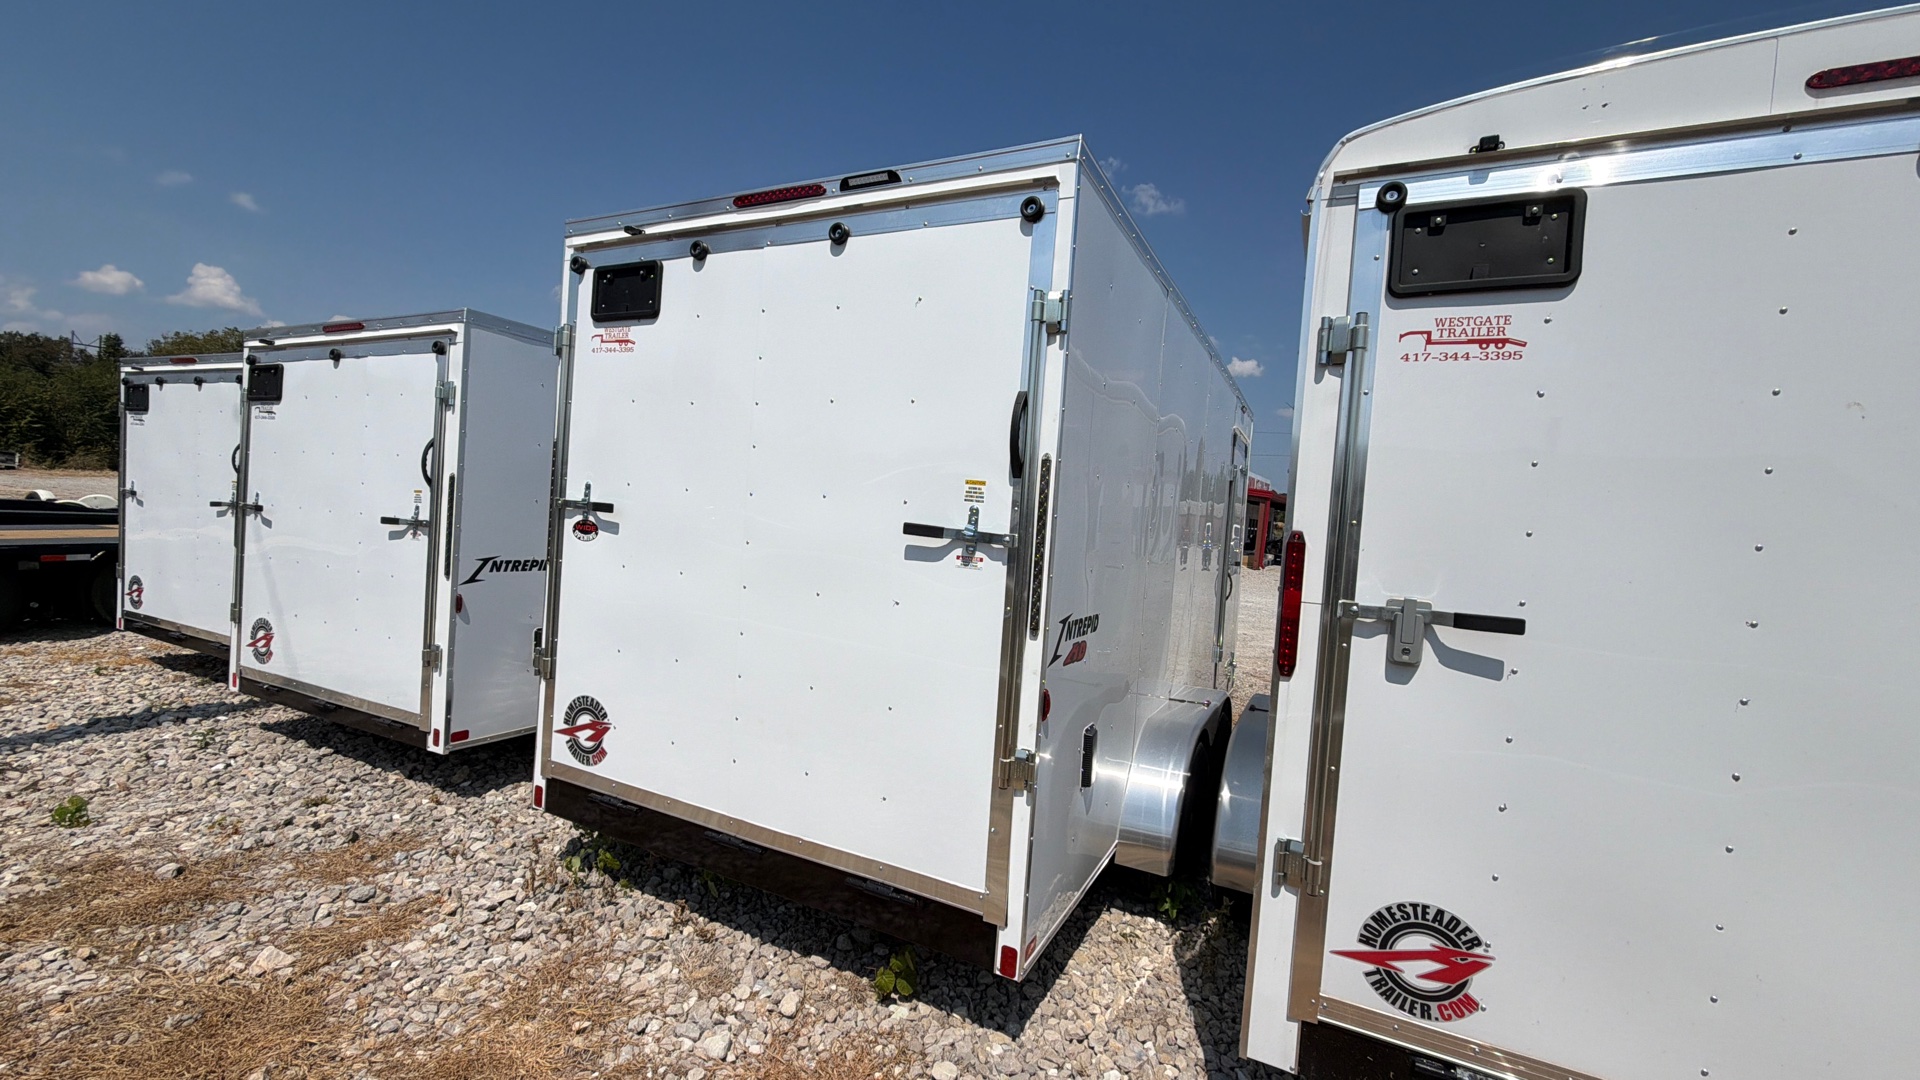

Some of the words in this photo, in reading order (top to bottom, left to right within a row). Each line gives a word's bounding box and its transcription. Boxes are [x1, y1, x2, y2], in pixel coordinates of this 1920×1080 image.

[1435, 315, 1512, 327] WESTGATE
[1437, 327, 1507, 338] TRAILER
[1400, 351, 1523, 362] 417-344-3395
[576, 524, 597, 532] WIDE
[458, 555, 548, 586] INTREPI
[1047, 612, 1100, 668] INTREPID
[563, 695, 608, 727] HOMESTEADER
[566, 738, 608, 767] TRAILER.COM
[1357, 902, 1483, 952] HOMESTEADER
[1365, 967, 1480, 1022] TRAILER.COM
